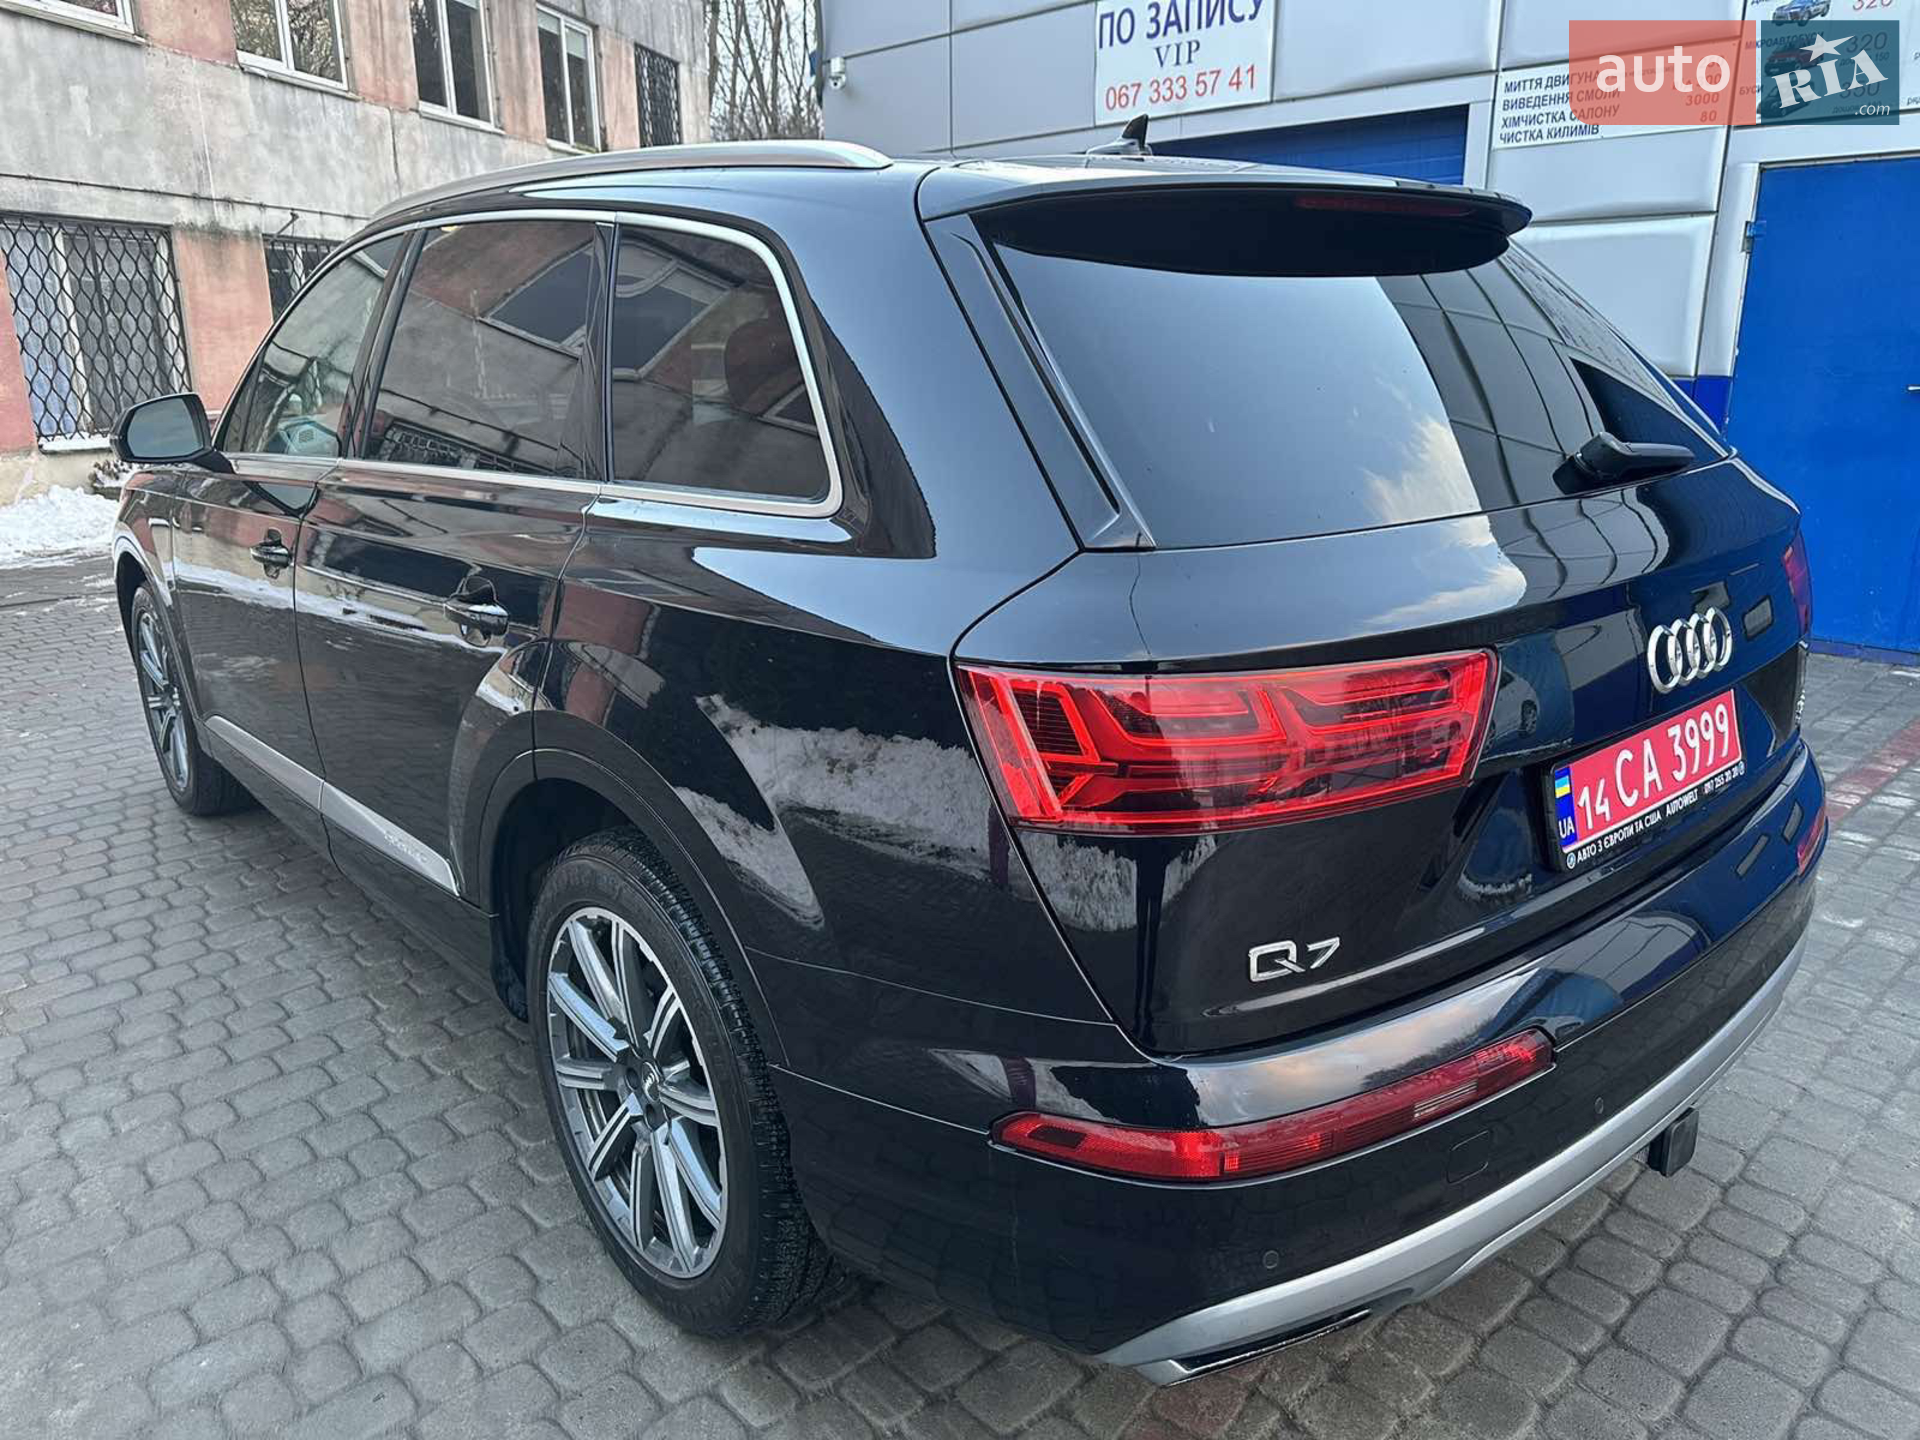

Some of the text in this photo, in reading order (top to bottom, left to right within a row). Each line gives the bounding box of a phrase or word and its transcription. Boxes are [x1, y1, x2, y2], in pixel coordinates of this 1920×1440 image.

[1099, 0, 1263, 49] ПО ЗАПИСУ
[1155, 39, 1201, 68] VIP
[1106, 64, 1255, 110] 067 333 57 41
[1504, 77, 1543, 93] МИТТЯ
[1502, 91, 1573, 111] ВИВЕДЕННЯ
[1685, 92, 1720, 106] 3000
[1501, 104, 1620, 129] ХІМЧИСТКА САЛОНУ
[1700, 110, 1718, 123] 80
[1500, 123, 1600, 144] ЧИСТКА КИЛИМІВ
[1576, 702, 1730, 830] 14 CA 3999
[1558, 816, 1575, 839] UA
[1577, 845, 1597, 863] АВТО
[1249, 937, 1340, 982] Q7
